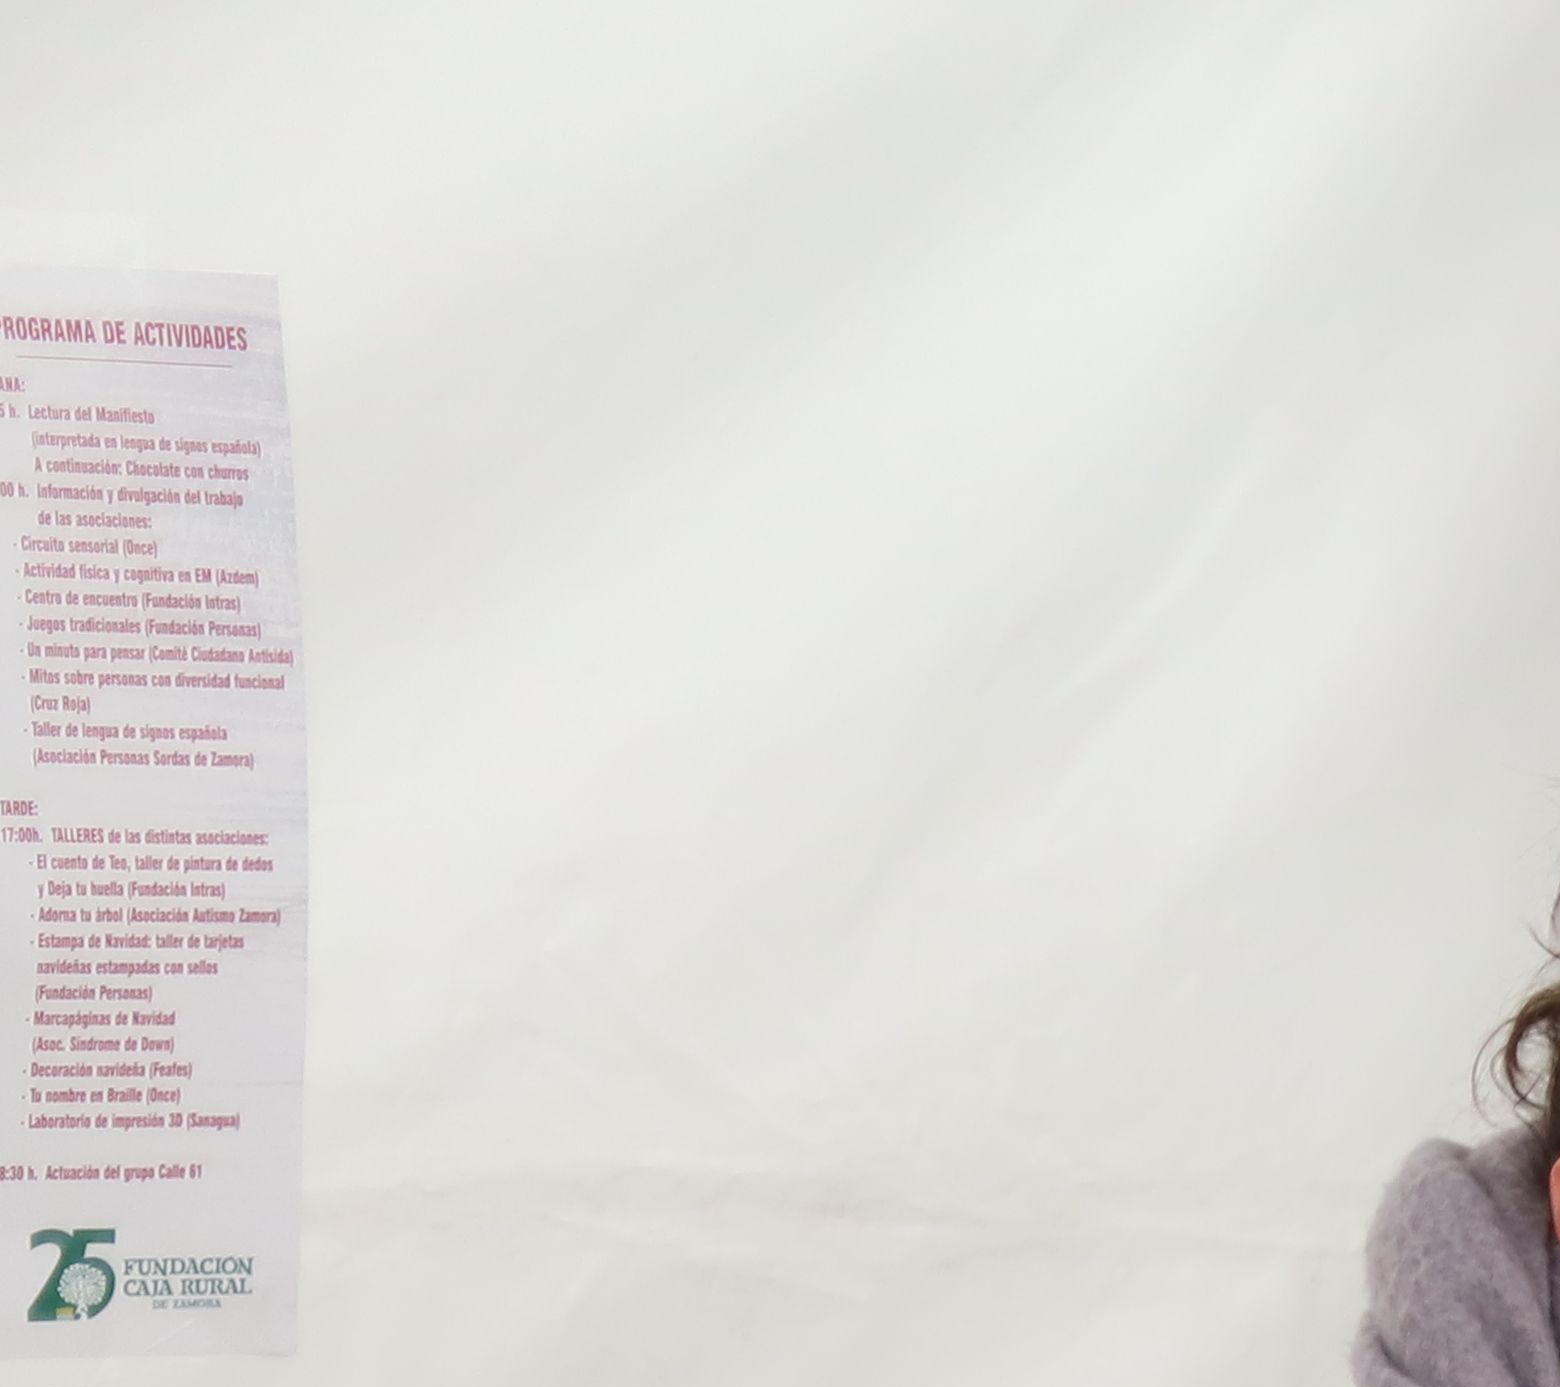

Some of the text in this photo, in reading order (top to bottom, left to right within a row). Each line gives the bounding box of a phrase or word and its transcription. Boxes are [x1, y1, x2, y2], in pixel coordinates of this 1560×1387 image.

[103, 321, 126, 345] DE
[134, 322, 248, 351] ACTIVIDADES
[28, 405, 155, 424] Lectura del Manifiesto
[35, 457, 249, 481] A continuación: Chocolate con churros
[21, 535, 157, 558] Circuito sensorial (Once)
[31, 695, 90, 715] (Cruz Roja)
[1, 800, 38, 817] TARDE:
[1, 827, 269, 846] 17:00h. TALLERES de las distintas asociaciones:
[34, 1010, 176, 1029] Marcapáginas de Navidad
[31, 1062, 192, 1080] Decoración navideña (Feafes)
[28, 1165, 37, 1181] h.
[45, 1165, 99, 1181] Actuación
[103, 1164, 120, 1181] del
[124, 1166, 155, 1183] grupo
[158, 1163, 185, 1179] Calle
[189, 1164, 202, 1179] 61
[27, 1228, 116, 1322] 25
[123, 1256, 254, 1277] FUNDACIÓN
[123, 1278, 253, 1297] CAJA RURAL
